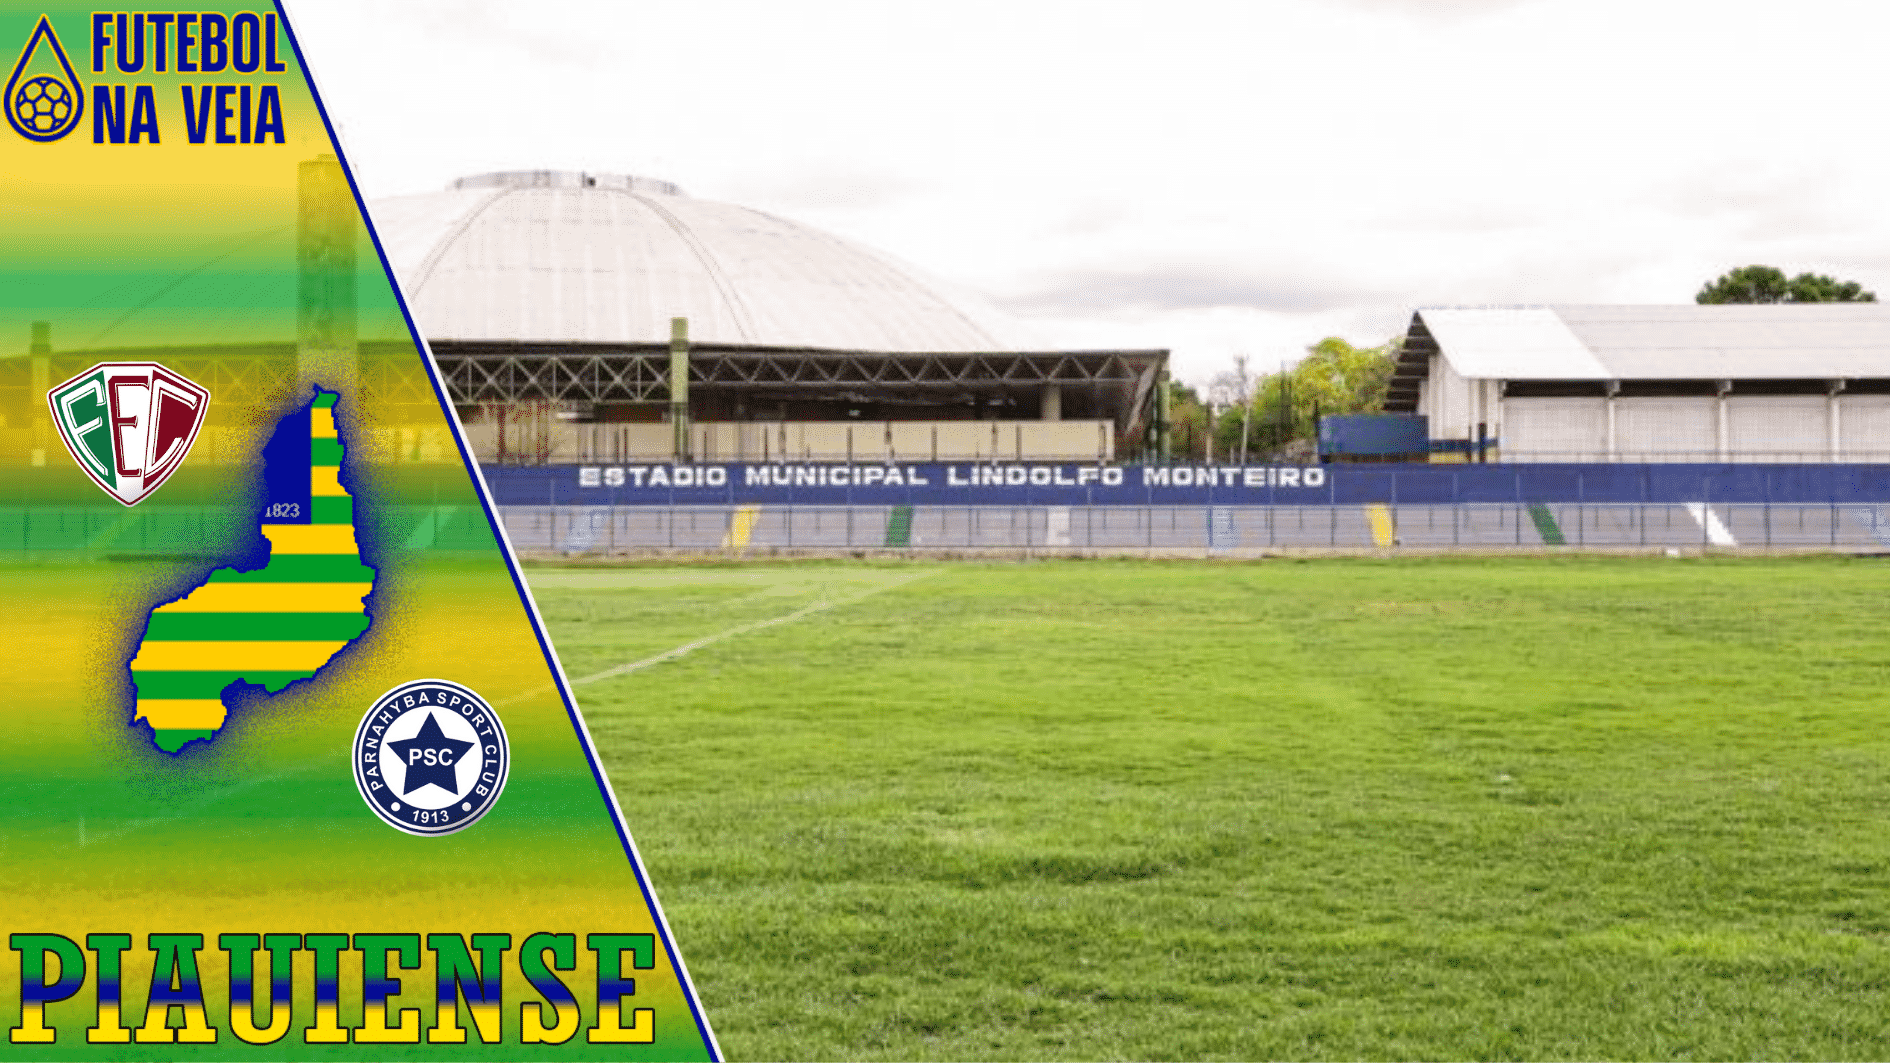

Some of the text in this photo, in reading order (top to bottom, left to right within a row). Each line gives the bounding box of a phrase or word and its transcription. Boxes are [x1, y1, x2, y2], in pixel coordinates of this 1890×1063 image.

[579, 466, 1326, 487] ESTADIO MUNICIPAL LINDOLFO MONTEIRO
